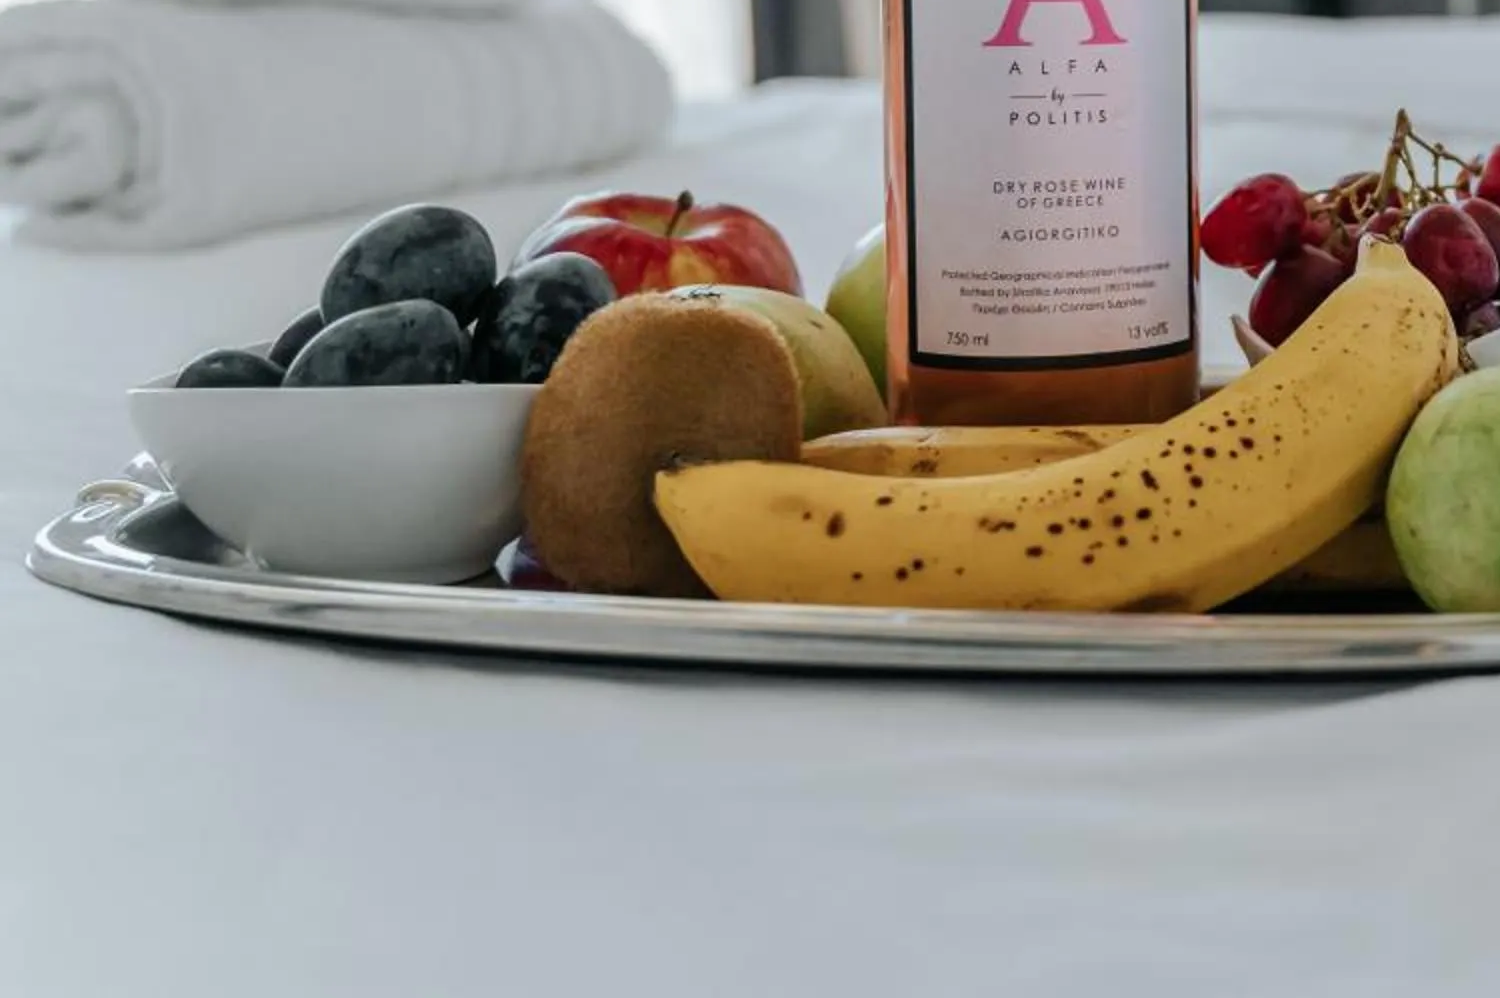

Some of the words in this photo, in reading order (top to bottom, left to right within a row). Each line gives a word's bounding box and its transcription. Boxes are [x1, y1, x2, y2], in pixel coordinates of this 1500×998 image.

[1008, 59, 1107, 75] ALFA
[1051, 86, 1065, 106] by
[1009, 109, 1107, 126] POLITIS
[993, 181, 1027, 194] DRY
[1033, 180, 1079, 193] ROSE
[1084, 177, 1126, 191] WINE
[1017, 197, 1037, 209] OF
[1043, 195, 1104, 209] GREECE
[1001, 225, 1120, 242] AGIORGITIKO
[947, 331, 970, 347] 750
[973, 333, 989, 346] ml
